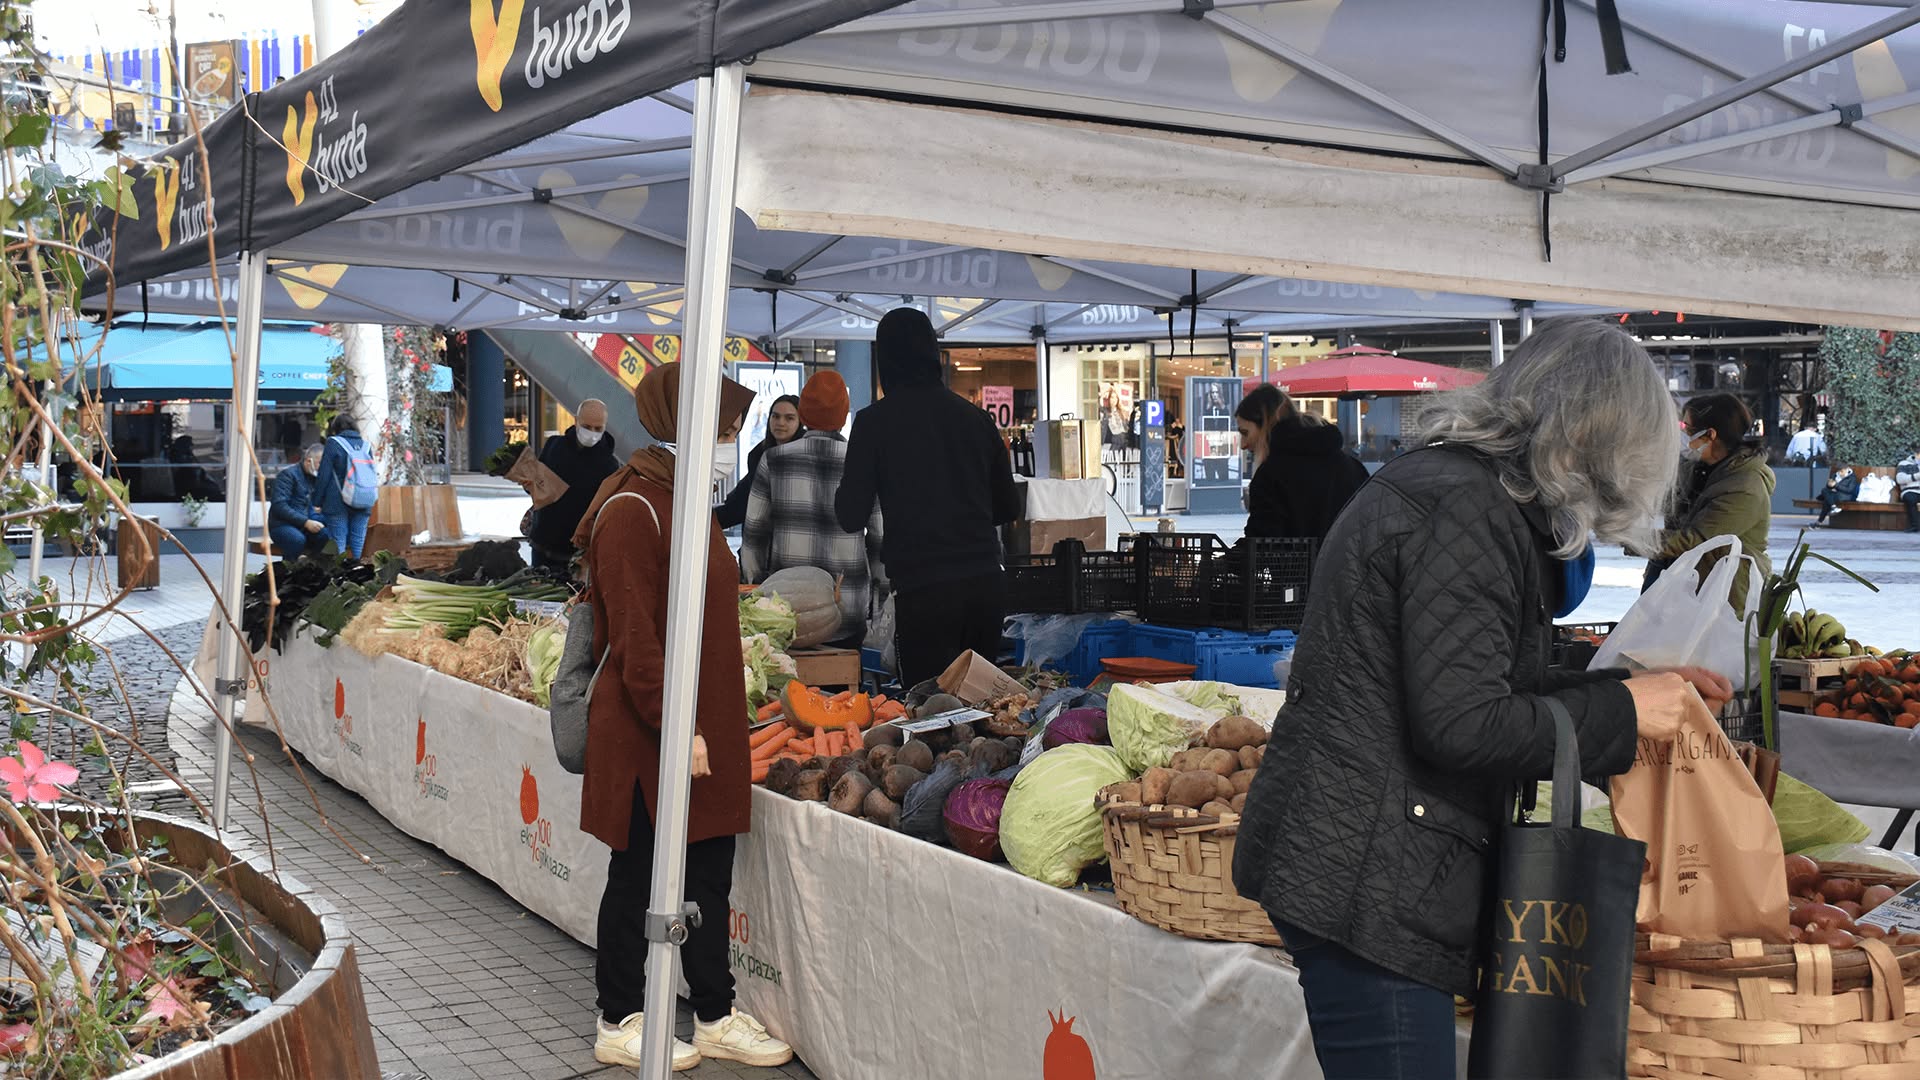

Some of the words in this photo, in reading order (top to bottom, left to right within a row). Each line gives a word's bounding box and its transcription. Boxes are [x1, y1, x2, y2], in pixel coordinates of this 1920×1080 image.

[525, 0, 631, 88] burda
[320, 74, 339, 125] 41
[315, 110, 367, 194] burda
[181, 152, 195, 191] 41
[655, 334, 671, 355] 26
[724, 337, 742, 357] 26
[620, 350, 638, 375] 26
[986, 403, 1011, 428] 50
[1147, 401, 1160, 425] P
[537, 817, 551, 848] 100
[727, 908, 749, 944] 00
[1502, 899, 1588, 950] YKO
[747, 955, 782, 986] pazar
